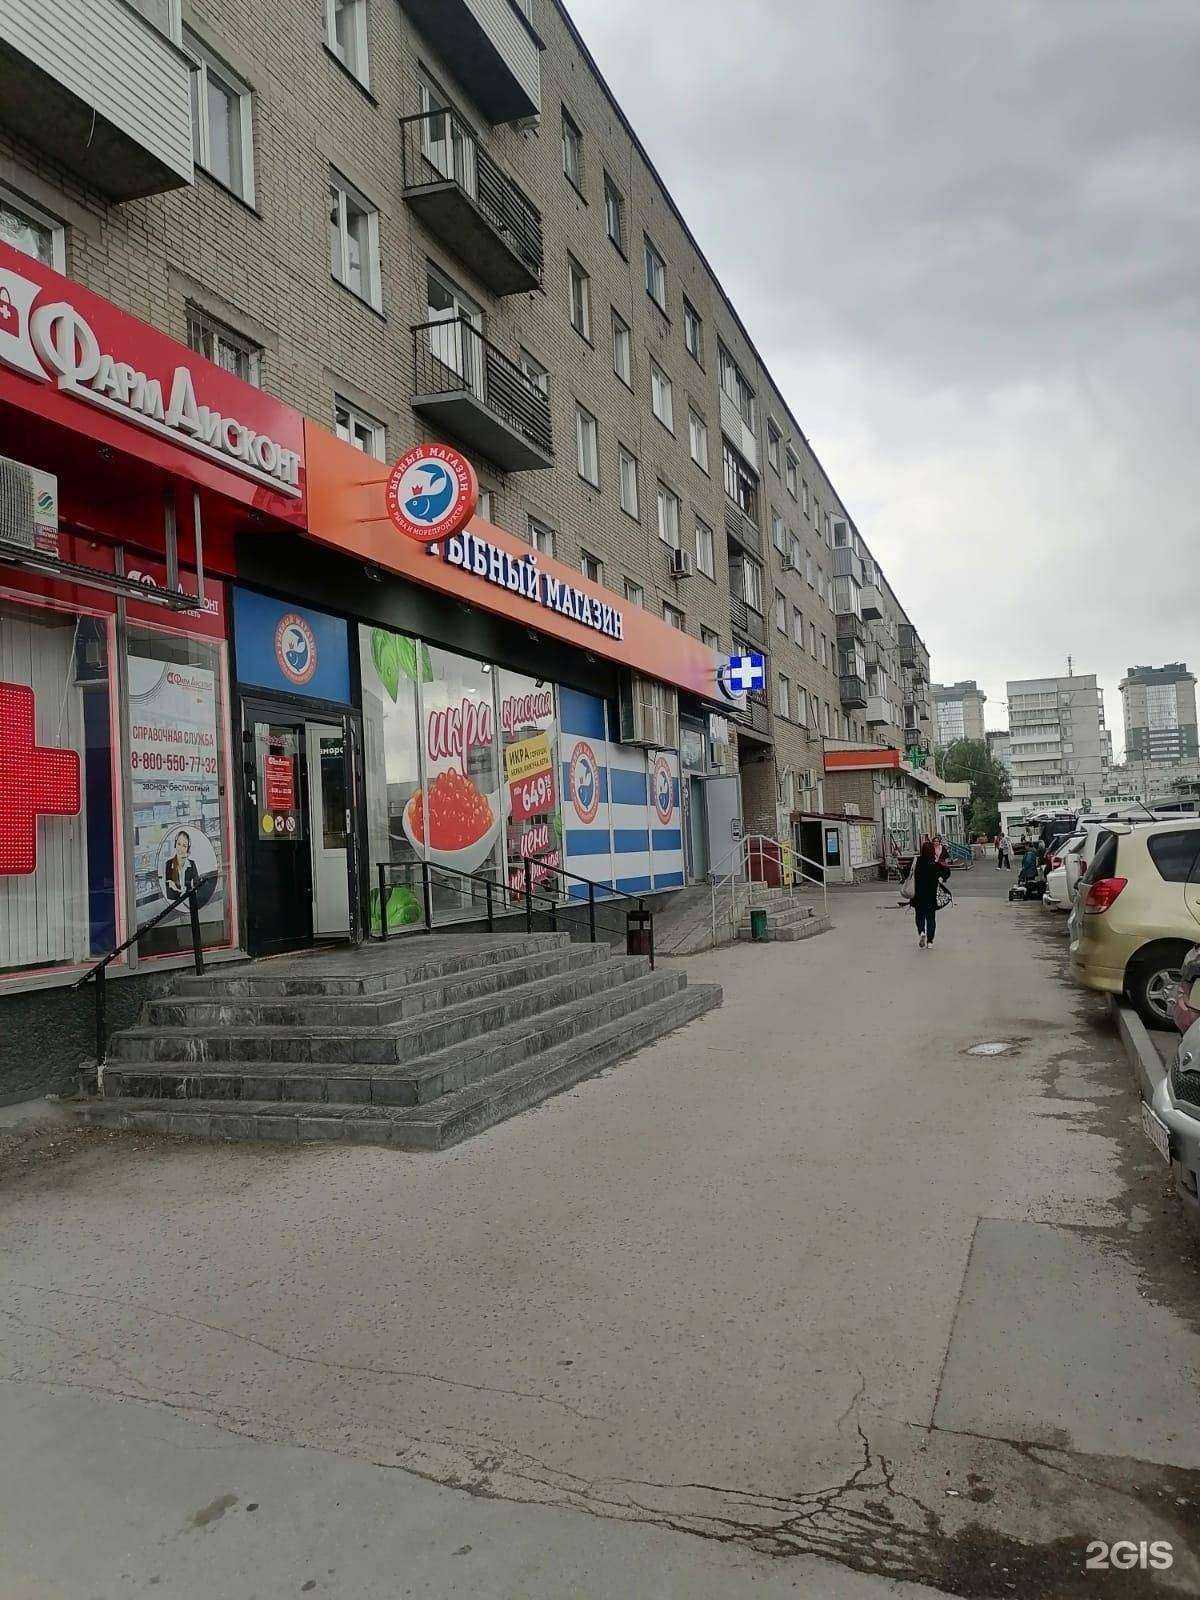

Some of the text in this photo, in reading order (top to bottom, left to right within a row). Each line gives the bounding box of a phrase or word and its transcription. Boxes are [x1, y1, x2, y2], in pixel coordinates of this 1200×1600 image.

[388, 447, 468, 499] РЫБНЫЙ МАГАЗИН
[430, 530, 624, 640] ЫБНЫЙ МАГАЗИН
[132, 725, 215, 748] СПРАВОЧНАЯ СЛУЖБА
[428, 697, 493, 780] икра
[131, 751, 217, 774] 8-800-550-77-32
[509, 747, 530, 767] ИКРА
[142, 782, 210, 793] звонок бесплатный
[522, 776, 546, 812] 649
[1033, 795, 1141, 807] оптика аптека
